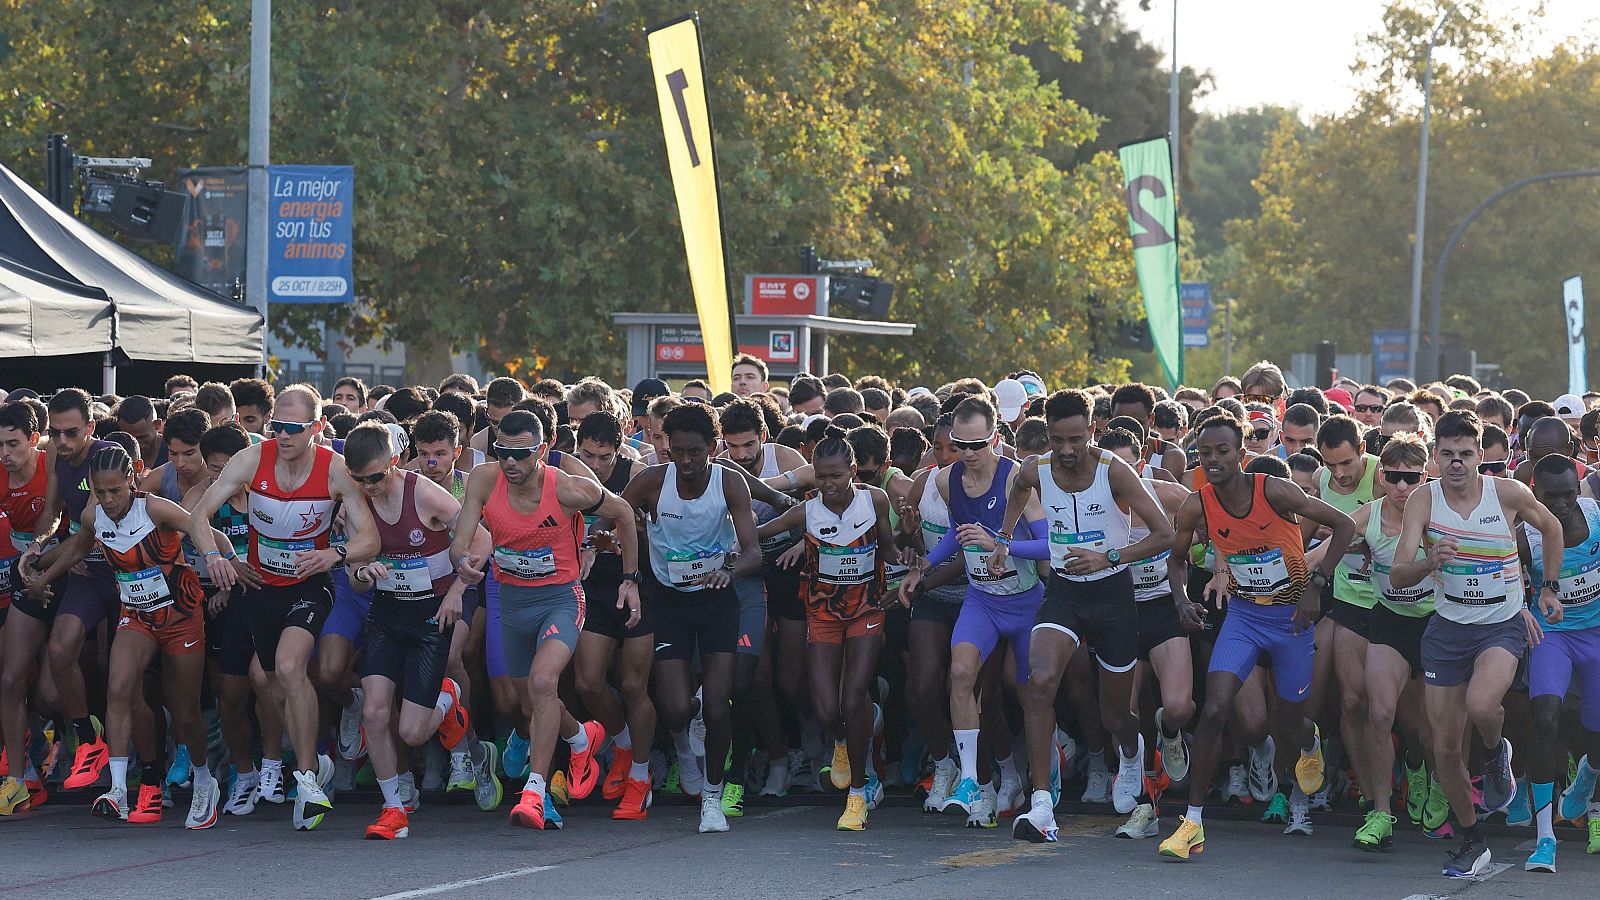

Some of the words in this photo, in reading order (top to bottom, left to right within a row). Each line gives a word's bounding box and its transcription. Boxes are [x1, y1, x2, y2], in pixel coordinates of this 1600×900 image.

[274, 176, 293, 197] La
[297, 177, 341, 201] mejor
[280, 196, 343, 221] energía
[276, 221, 305, 238] son
[309, 218, 332, 238] tus
[284, 239, 346, 259] ánimos
[278, 281, 290, 291] 25
[292, 281, 310, 291] OCT
[311, 281, 316, 292] /
[317, 281, 342, 291] 8:25H
[661, 512, 684, 520] BROOKS
[1480, 515, 1501, 525] HOKA
[280, 552, 291, 560] 47
[267, 559, 280, 568] Van
[517, 558, 529, 566] 30
[691, 561, 703, 570] 86
[840, 557, 857, 565] 205
[1143, 565, 1155, 573] 52
[1247, 566, 1263, 576] 147
[394, 572, 406, 581] 35
[1249, 578, 1271, 586] PACER
[1466, 578, 1479, 587] 33
[1573, 576, 1586, 587] 34
[129, 583, 145, 593] 201
[1570, 582, 1600, 598] KIPRUTO
[1463, 590, 1484, 598] ROJO
